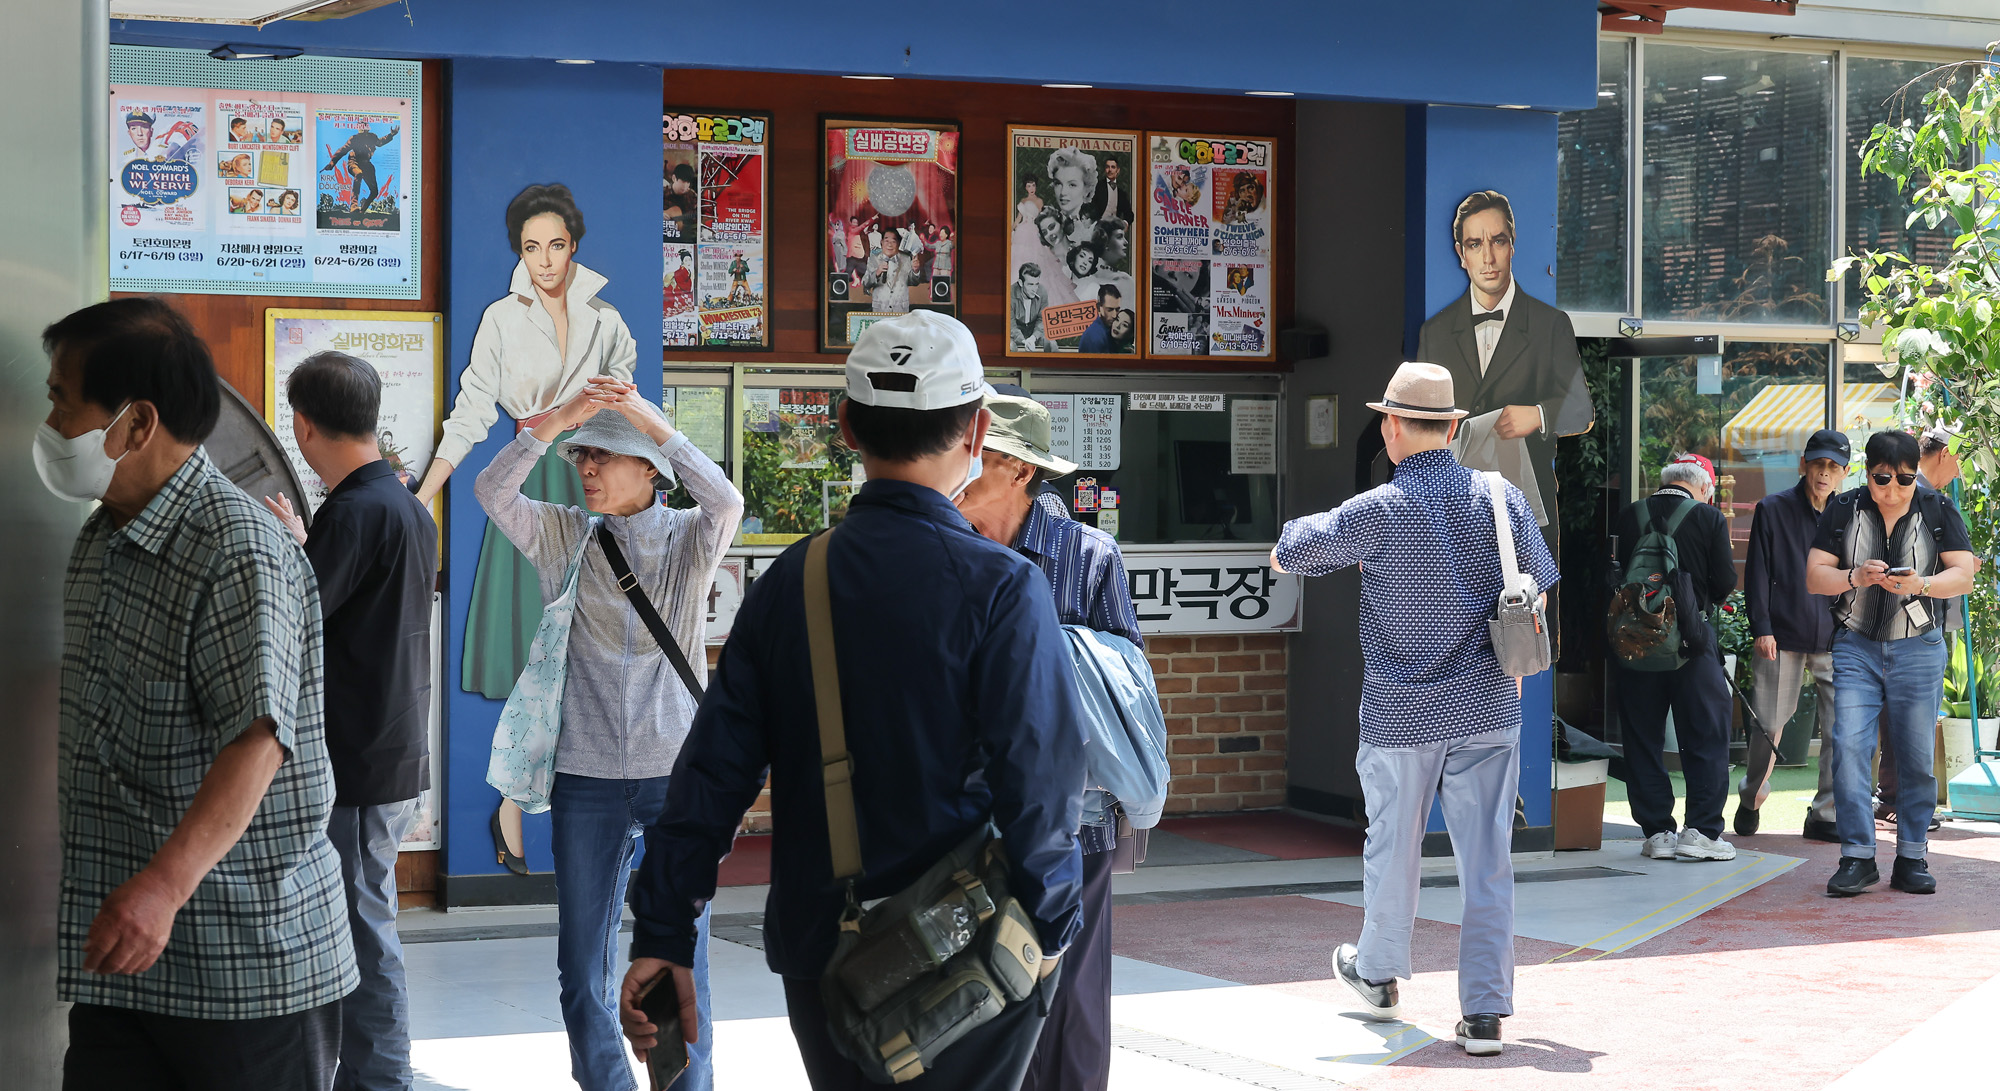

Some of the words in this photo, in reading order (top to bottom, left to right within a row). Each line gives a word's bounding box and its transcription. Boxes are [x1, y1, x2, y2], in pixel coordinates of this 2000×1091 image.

[856, 132, 927, 152] 실버공연장
[1017, 136, 1051, 147] CINE
[1060, 139, 1130, 151] ROMANCE
[1179, 139, 1266, 166] 영화프로그램
[152, 164, 189, 172] COWARD'S
[148, 172, 190, 182] WHICH
[129, 180, 148, 189] WE
[1154, 188, 1192, 215] GABLE
[1160, 206, 1209, 228] TURNER
[712, 222, 751, 231] 콰이강의다리
[1154, 226, 1209, 237] SOMEWHERE
[1226, 222, 1256, 233] TWELVE
[1214, 229, 1244, 240] O'CLOCK
[1246, 228, 1265, 240] HIGH
[220, 244, 260, 254] 지상에서
[263, 245, 303, 255] 영원으로
[340, 244, 377, 254] 영광의길
[120, 251, 175, 260] 6/17~6/19
[178, 252, 204, 262] (3일)
[314, 257, 374, 266] 6/24~6/26
[377, 258, 401, 267] (3일)
[217, 257, 276, 267] 6/20~6/21
[280, 258, 306, 268] (2일)
[700, 309, 751, 325] WINCHESTER
[1047, 306, 1095, 325] 낭만극장
[1050, 328, 1071, 336] CLASSIC
[1073, 324, 1091, 332] CINEM
[1159, 324, 1185, 334] CRANES
[330, 332, 424, 351] 실버영화관
[1223, 333, 1255, 342] 미니버부인
[1220, 342, 1258, 350] 6/13~6/15
[1081, 397, 1114, 405] 상영일정표
[780, 404, 829, 415] 부정선거
[1082, 414, 1096, 422] 학이
[1099, 414, 1112, 423] 난다
